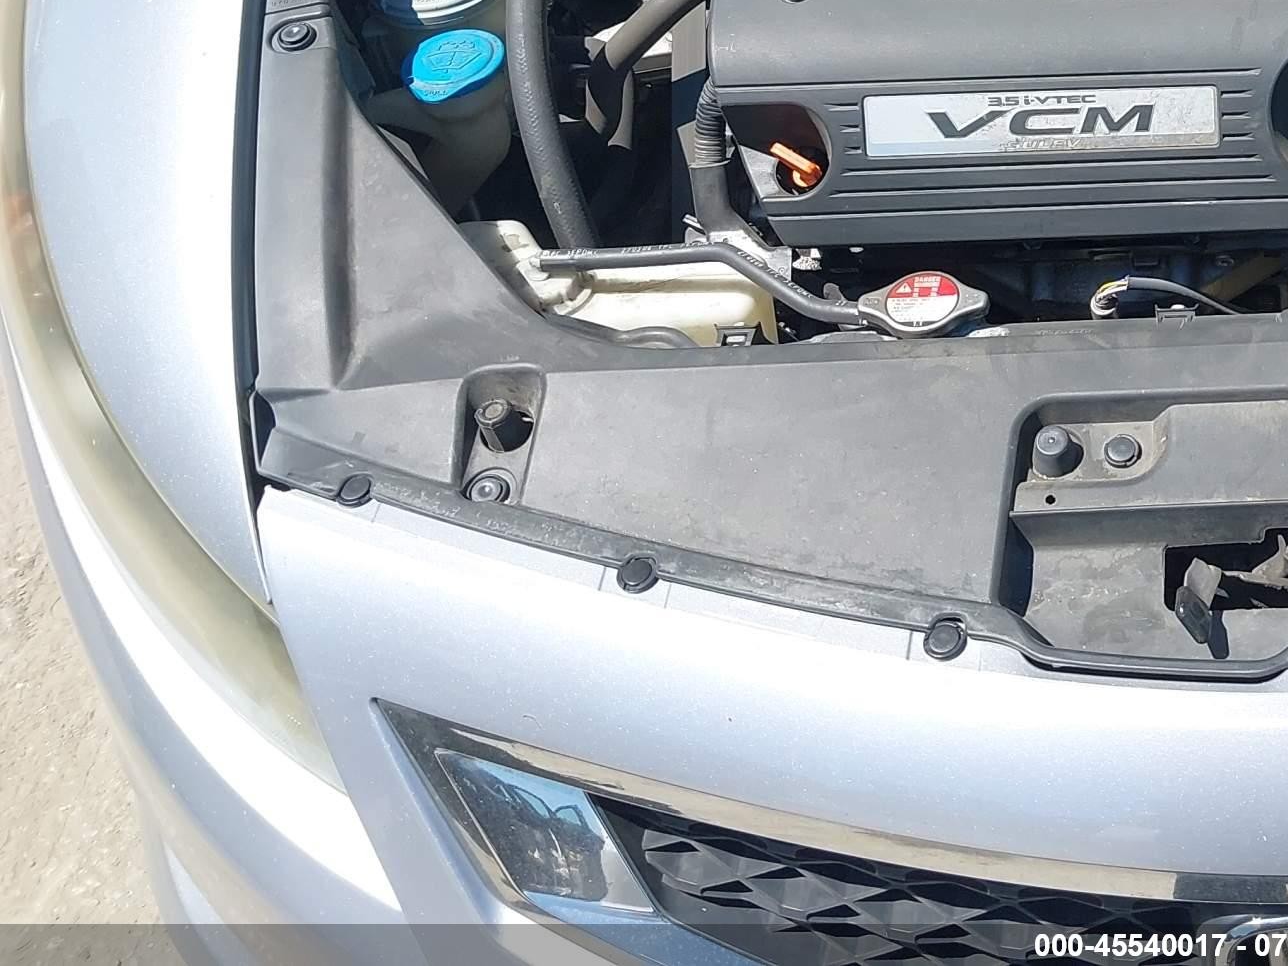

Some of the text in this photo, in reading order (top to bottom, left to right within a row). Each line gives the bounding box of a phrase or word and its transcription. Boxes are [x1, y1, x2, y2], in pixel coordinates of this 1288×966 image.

[987, 94, 1097, 107] 3.5 i-VTEC
[926, 103, 1155, 139] VCM
